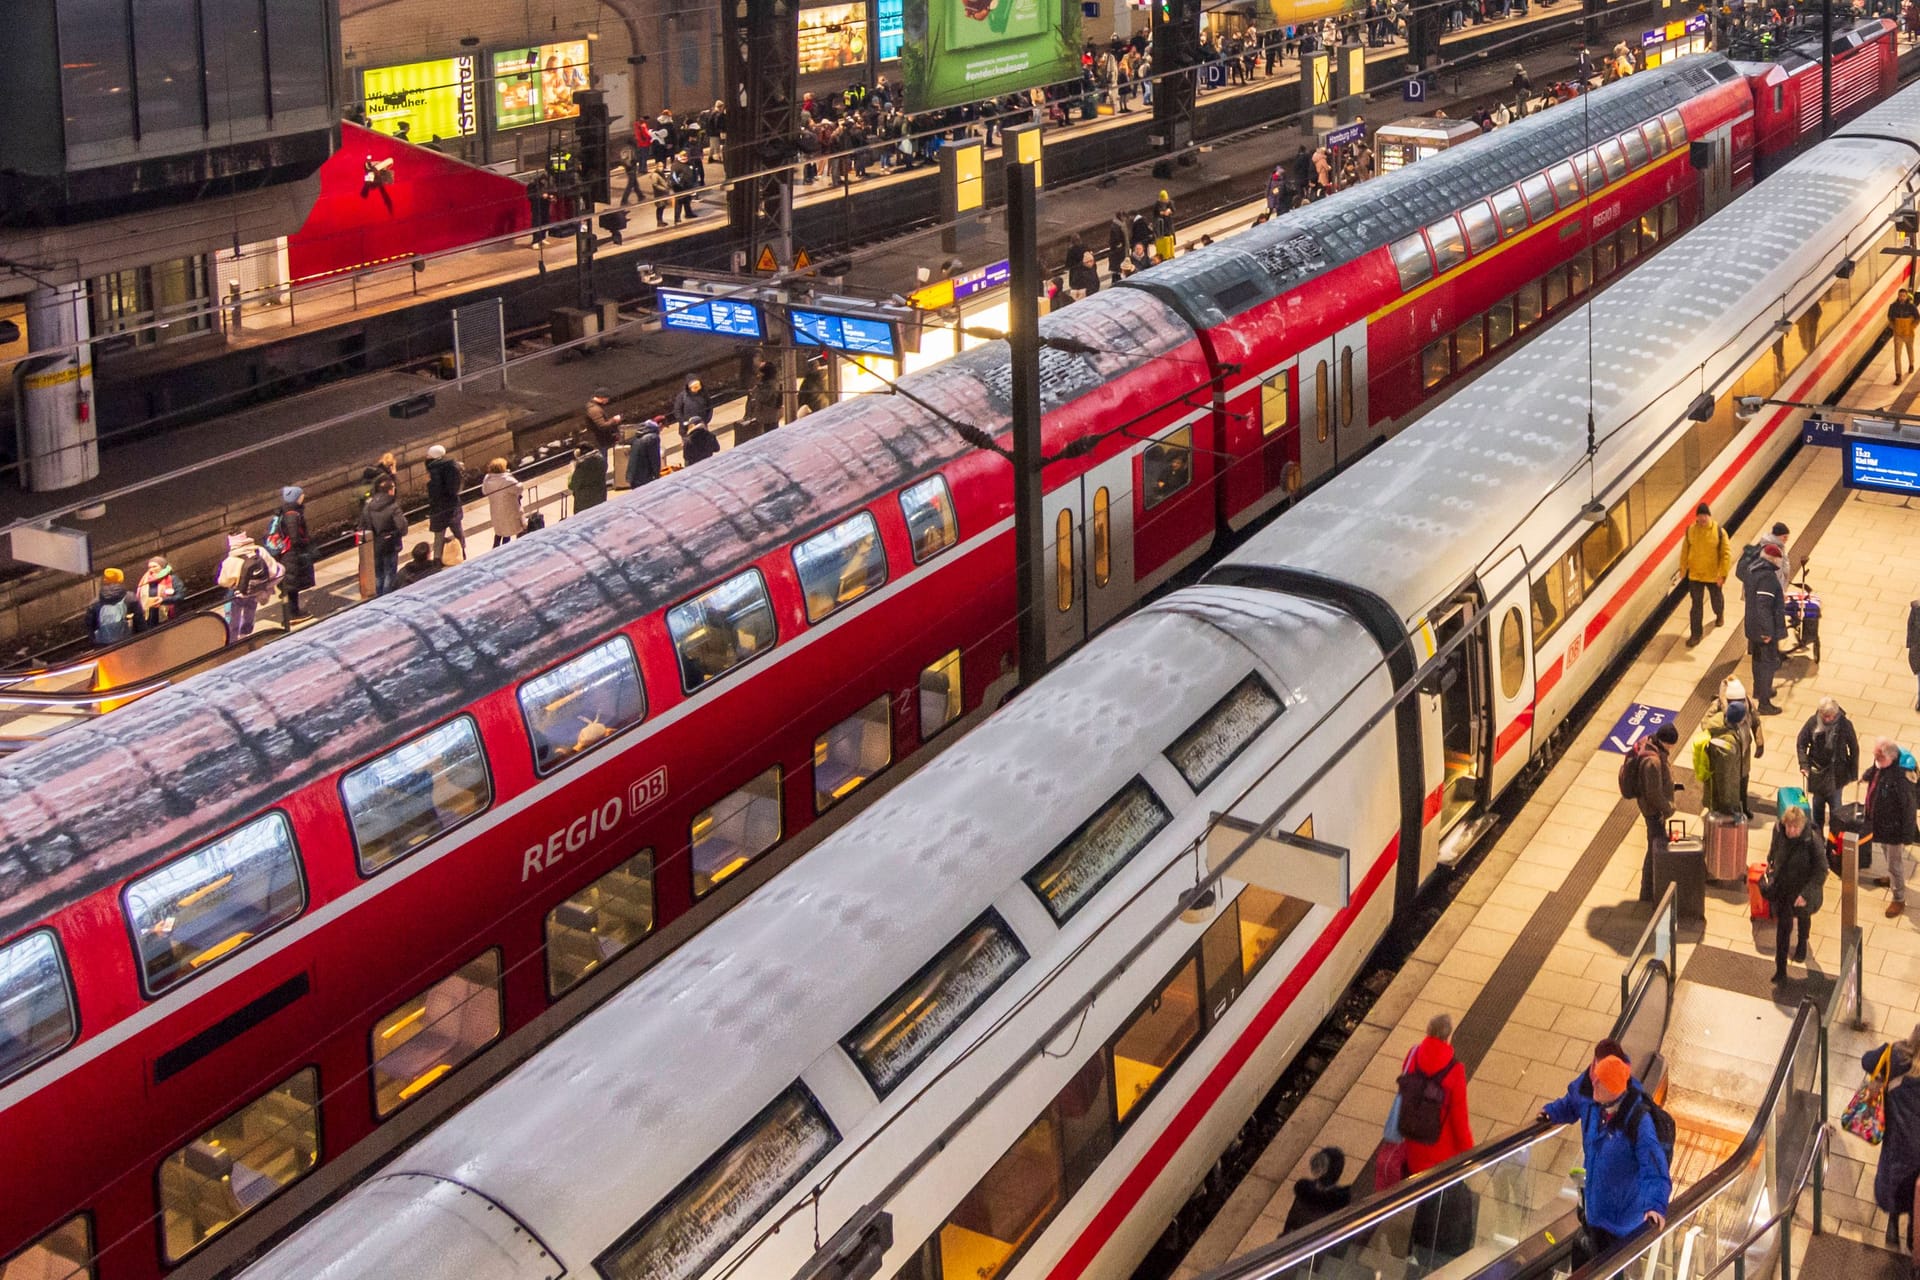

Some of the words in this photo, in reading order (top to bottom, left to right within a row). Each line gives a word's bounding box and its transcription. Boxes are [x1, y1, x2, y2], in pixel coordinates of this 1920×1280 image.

[1209, 66, 1220, 82] D
[1409, 81, 1421, 98] D
[1815, 422, 1821, 431] 7
[901, 688, 912, 714] 2
[521, 796, 623, 883] REGIO
[632, 769, 666, 812] DB
